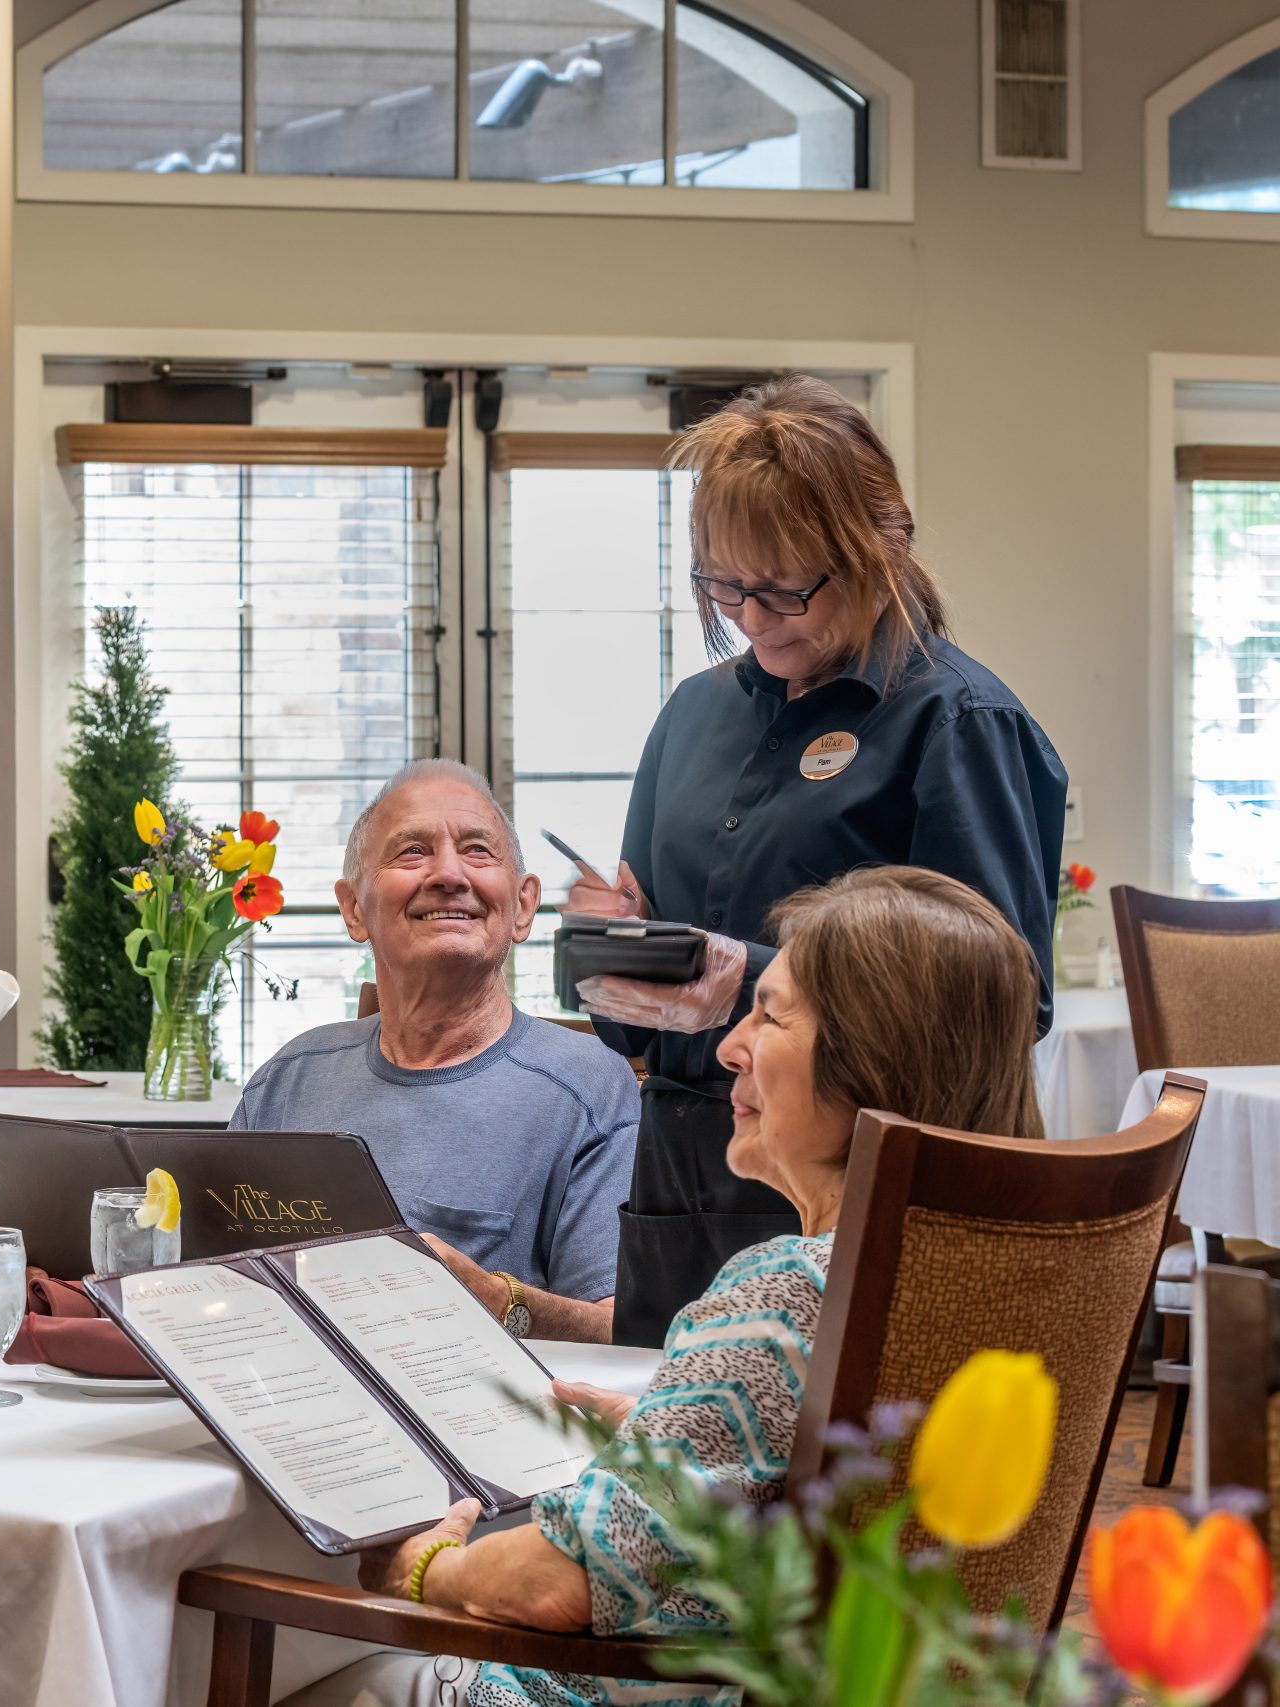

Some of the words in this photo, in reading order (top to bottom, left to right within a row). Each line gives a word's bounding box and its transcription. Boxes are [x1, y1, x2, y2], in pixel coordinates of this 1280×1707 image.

[235, 1184, 270, 1200] The
[206, 1189, 332, 1221] VILLAGE
[254, 1225, 344, 1234] OCOTILLO
[165, 1283, 203, 1296] GRILLE
